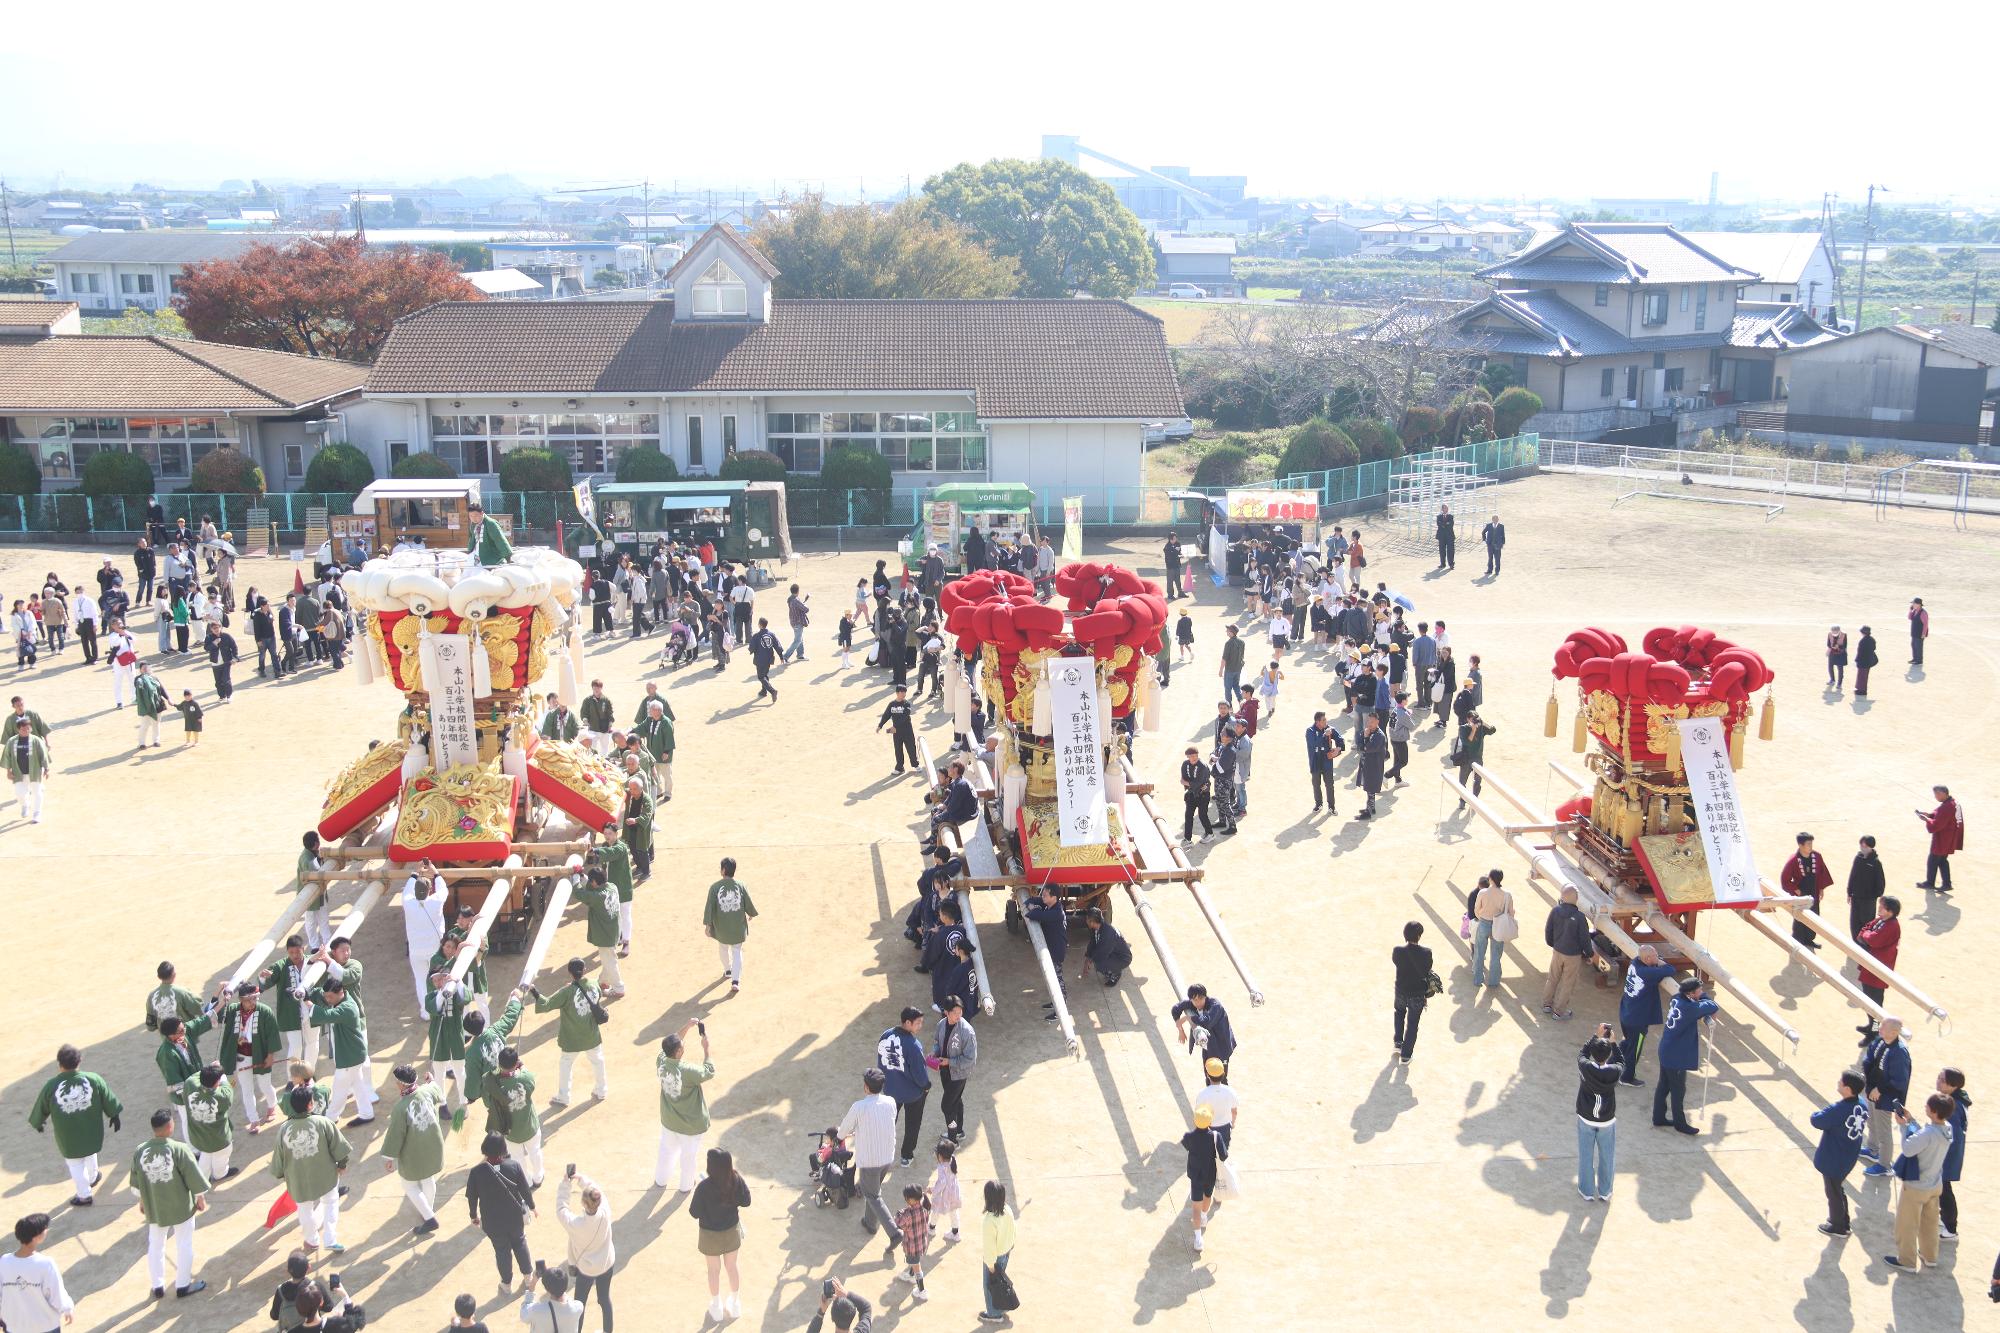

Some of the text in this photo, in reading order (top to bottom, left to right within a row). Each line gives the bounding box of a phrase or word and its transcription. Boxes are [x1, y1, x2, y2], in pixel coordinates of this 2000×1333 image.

[445, 686, 458, 742] 百三十四年間
[454, 666, 470, 751] 本山小学校閉校記念
[1071, 712, 1085, 776] 百三十四年間
[1079, 690, 1097, 787] 本山小学校閉校記念
[1706, 770, 1729, 833] 百三十四年間
[1712, 749, 1742, 843] 本山小学校閉校記念
